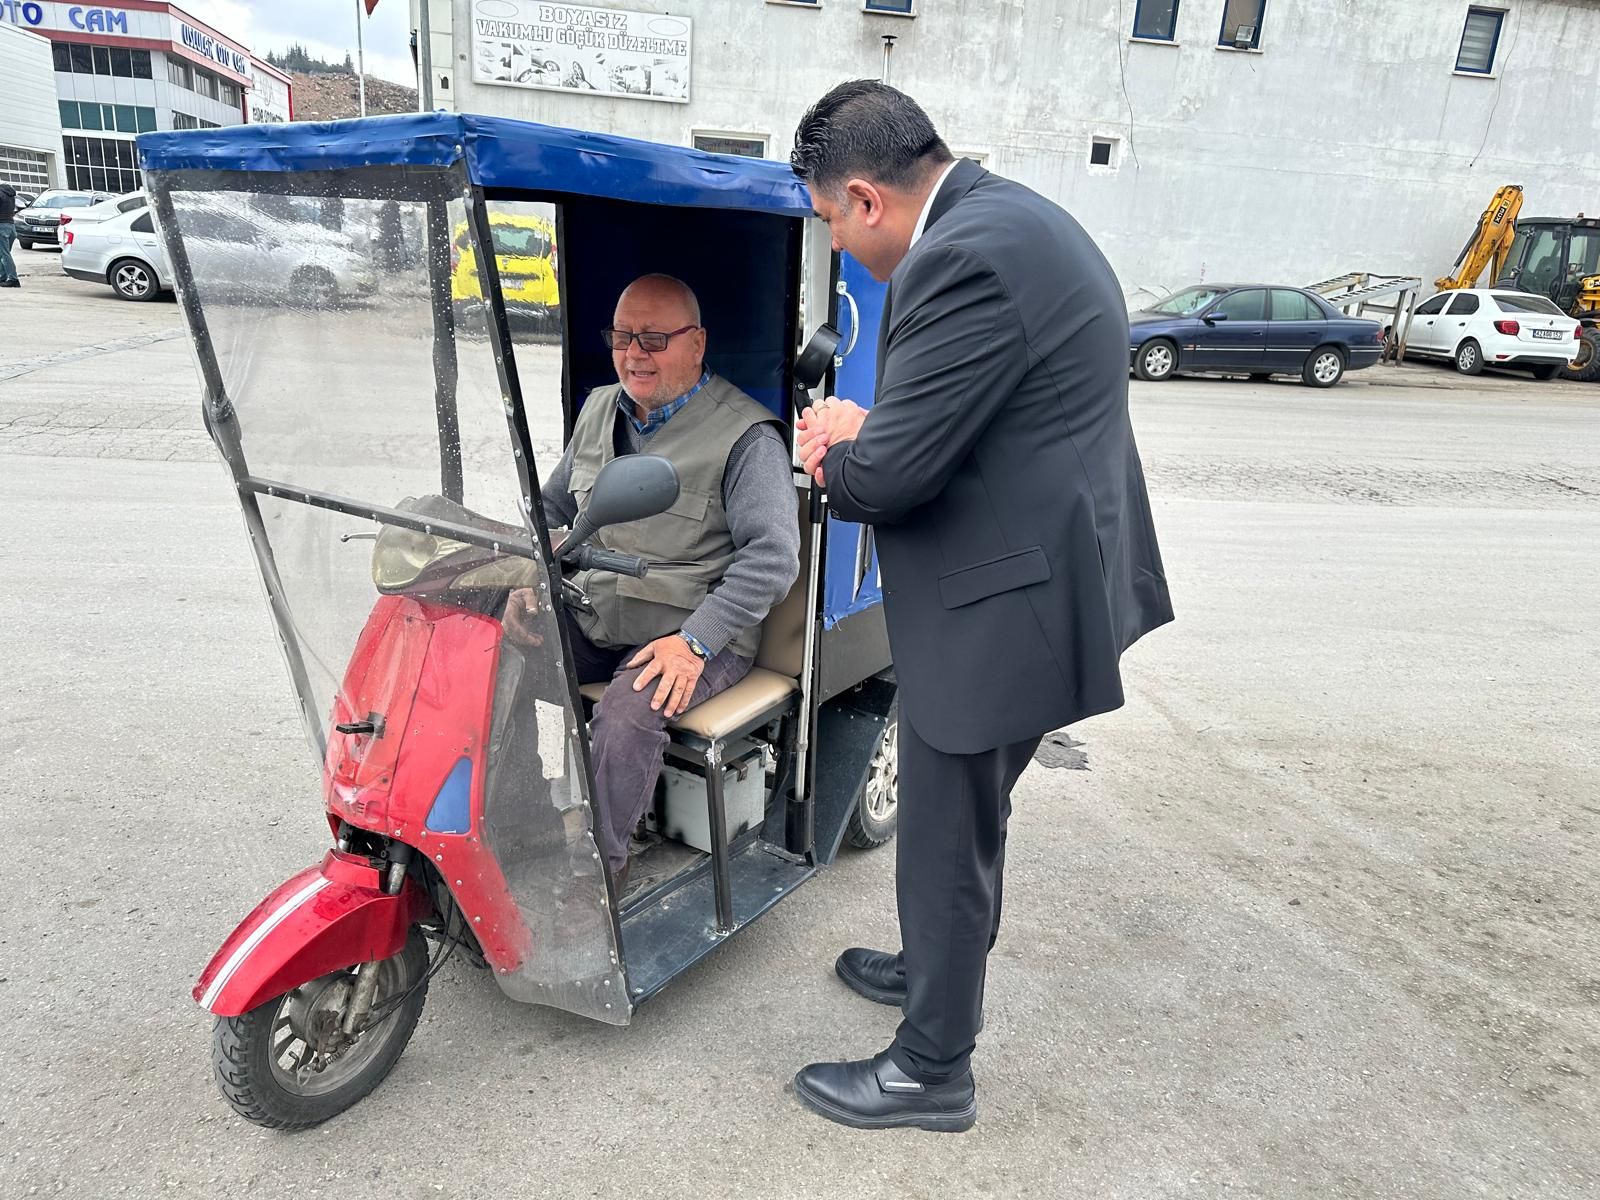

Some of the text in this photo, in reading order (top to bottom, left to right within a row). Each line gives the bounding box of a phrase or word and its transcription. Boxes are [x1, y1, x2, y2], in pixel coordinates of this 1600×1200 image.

[68, 6, 128, 34] CAM
[538, 5, 628, 31] BOYASIZ
[475, 18, 687, 57] VAKUMLU GÖÇÜK DÜZELTME
